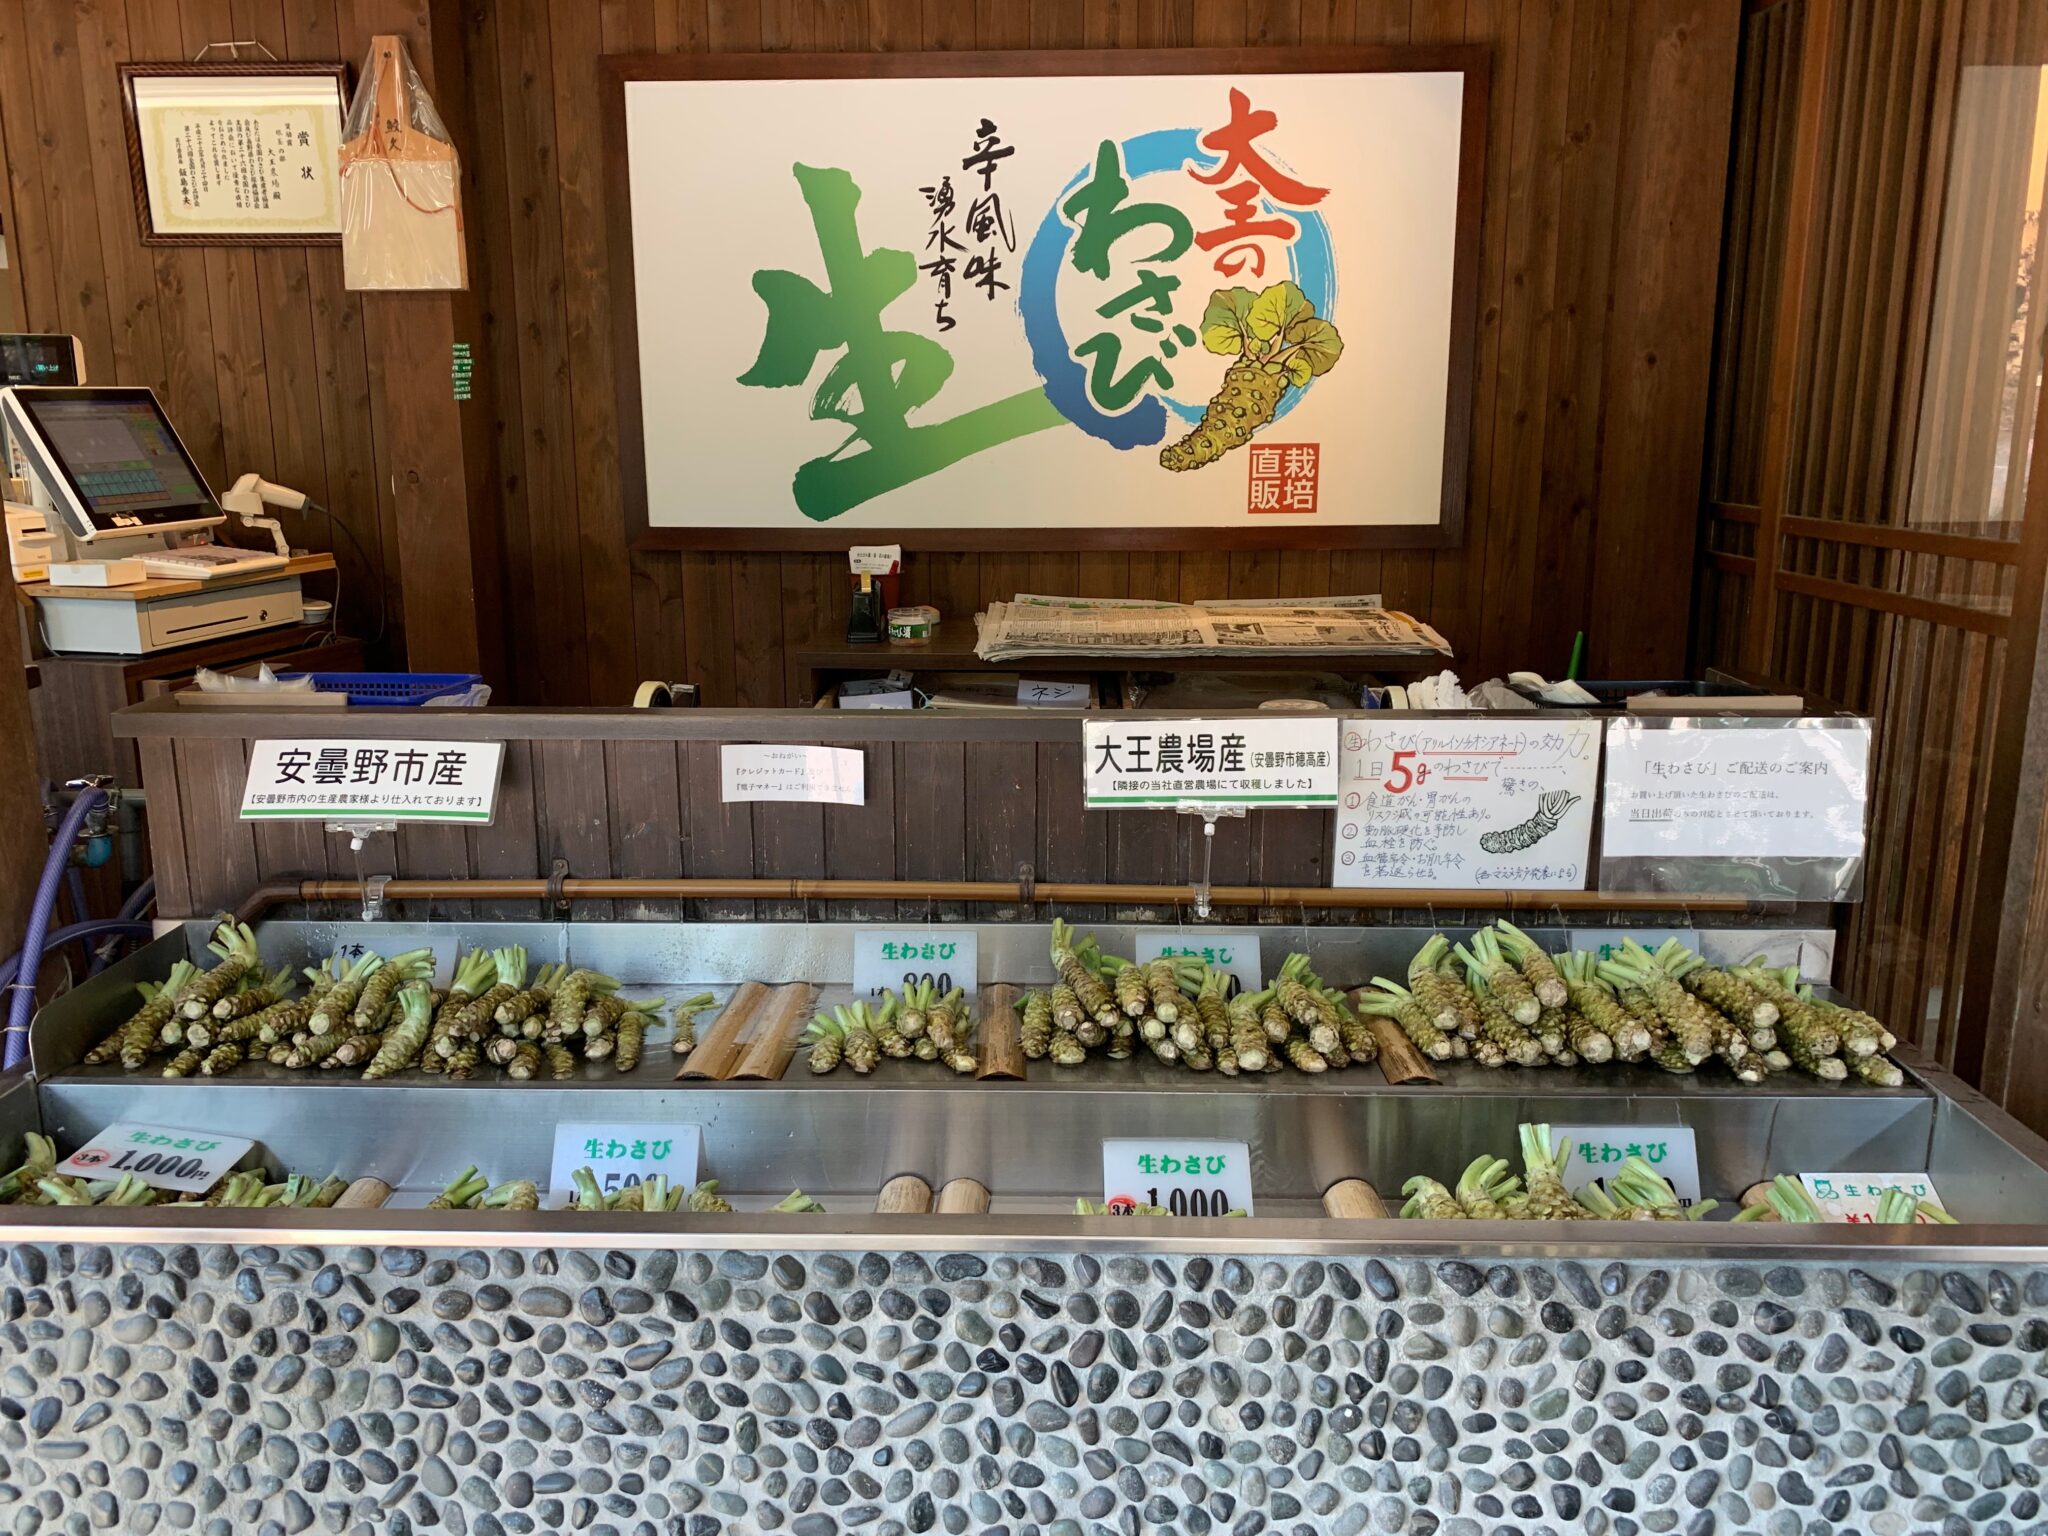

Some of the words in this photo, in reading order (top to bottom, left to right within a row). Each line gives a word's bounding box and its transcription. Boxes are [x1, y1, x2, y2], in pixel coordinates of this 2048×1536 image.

[297, 130, 315, 181] 賞状
[1188, 86, 1332, 280] 大王の
[962, 117, 1016, 301] 辛風味
[918, 176, 969, 332] 湧水育ち
[1064, 138, 1199, 411] わさび
[736, 162, 1075, 525] 生
[1249, 447, 1283, 510] 直販
[1283, 446, 1316, 510] 栽培
[1032, 684, 1076, 706] ネジ
[275, 747, 467, 786] 安曇野市産
[1094, 733, 1247, 774] 大王農場産
[881, 942, 957, 961] 生わさび
[126, 1131, 222, 1151] 生わさび
[584, 1138, 672, 1161] 生わさび
[1578, 1142, 1667, 1164] 生わさび
[604, 1173, 657, 1193] 50
[1137, 1154, 1227, 1175] 生わさび
